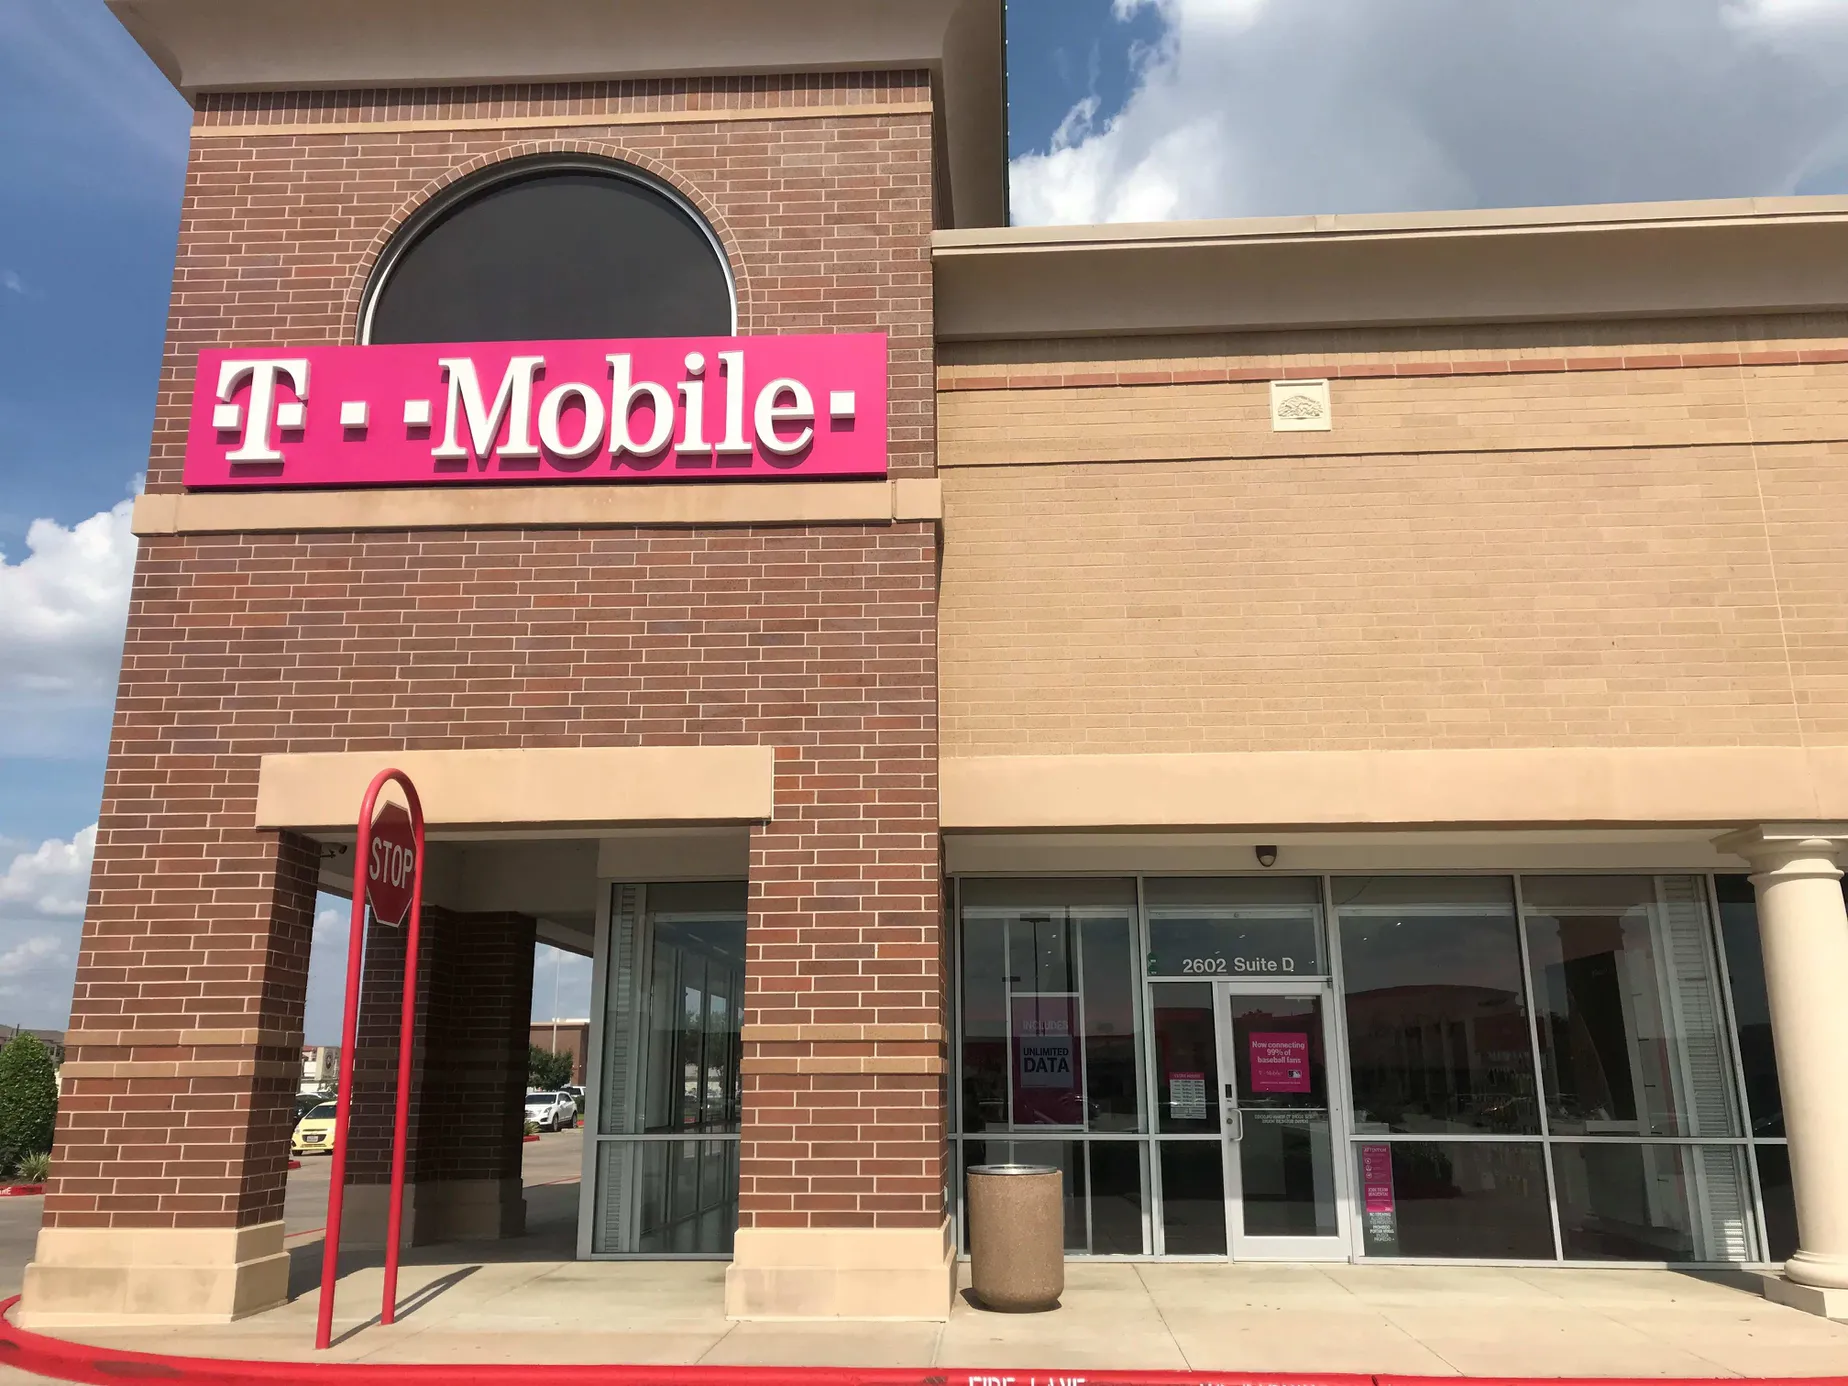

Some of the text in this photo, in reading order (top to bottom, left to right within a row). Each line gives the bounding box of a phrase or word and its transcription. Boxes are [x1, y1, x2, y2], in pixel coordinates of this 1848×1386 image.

[369, 836, 414, 889] STOP
[1182, 957, 1294, 973] 2602 Suite D
[1023, 1020, 1069, 1030] INCLUDES
[1023, 1047, 1069, 1056] UNLIMITED
[1268, 1041, 1305, 1050] connecting
[1023, 1057, 1070, 1073] DATA
